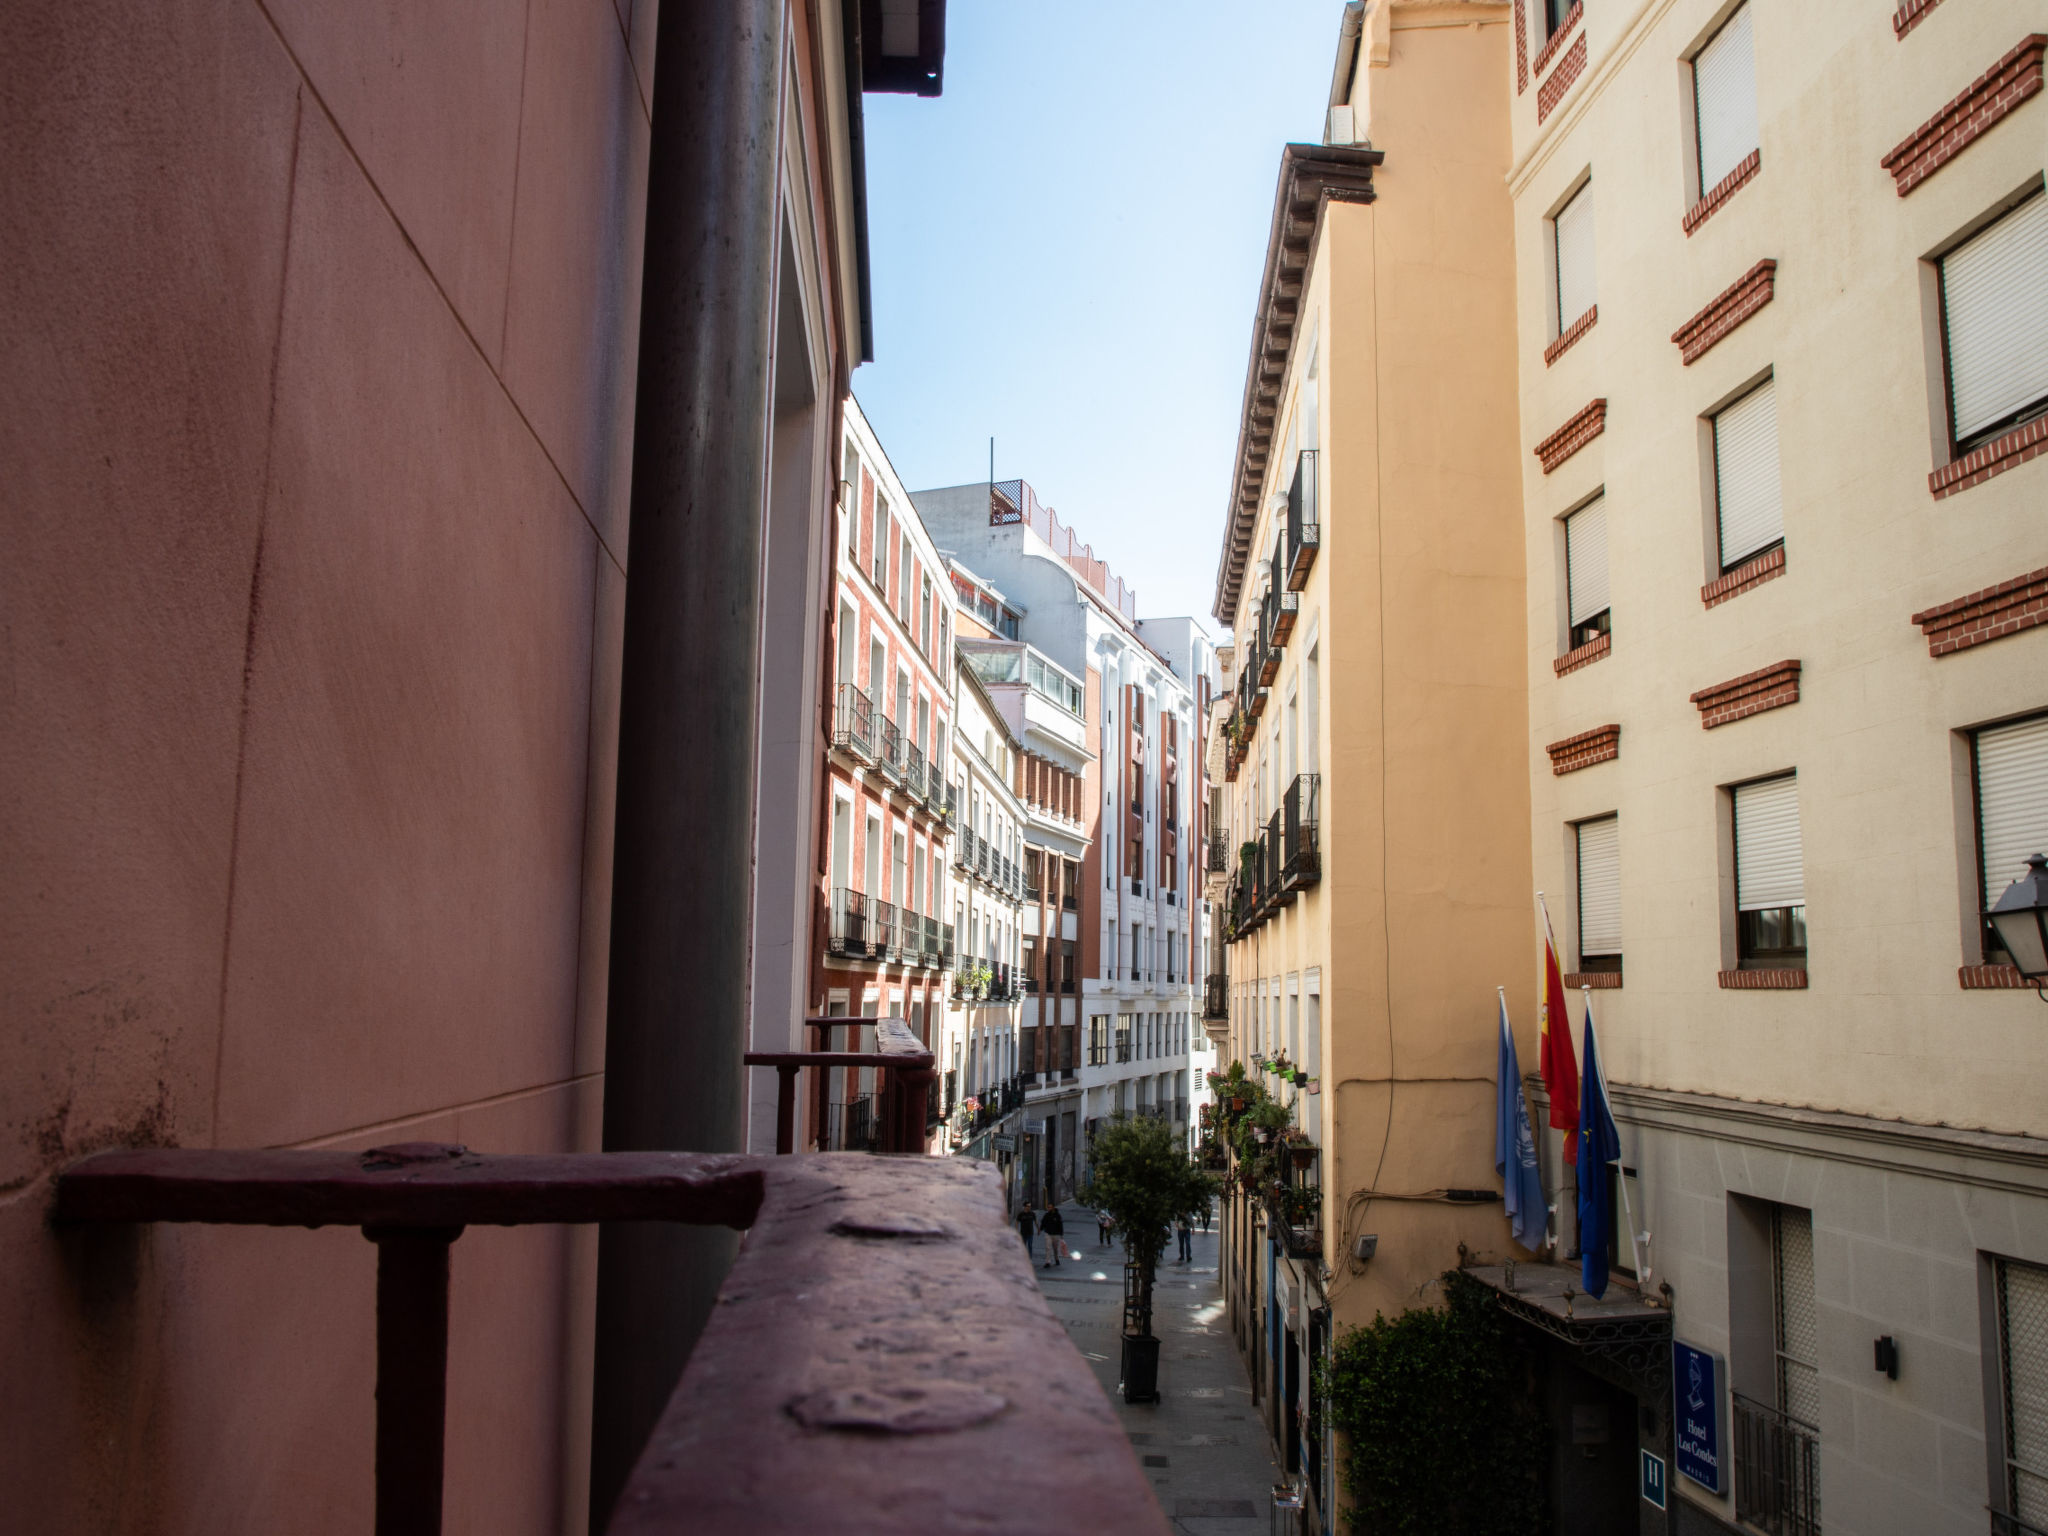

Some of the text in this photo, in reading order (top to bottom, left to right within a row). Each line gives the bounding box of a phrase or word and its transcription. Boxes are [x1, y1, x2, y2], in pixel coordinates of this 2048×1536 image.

[1688, 1418, 1706, 1440] Hotel
[1678, 1433, 1717, 1467] Los Condes
[1649, 1459, 1658, 1487] H
